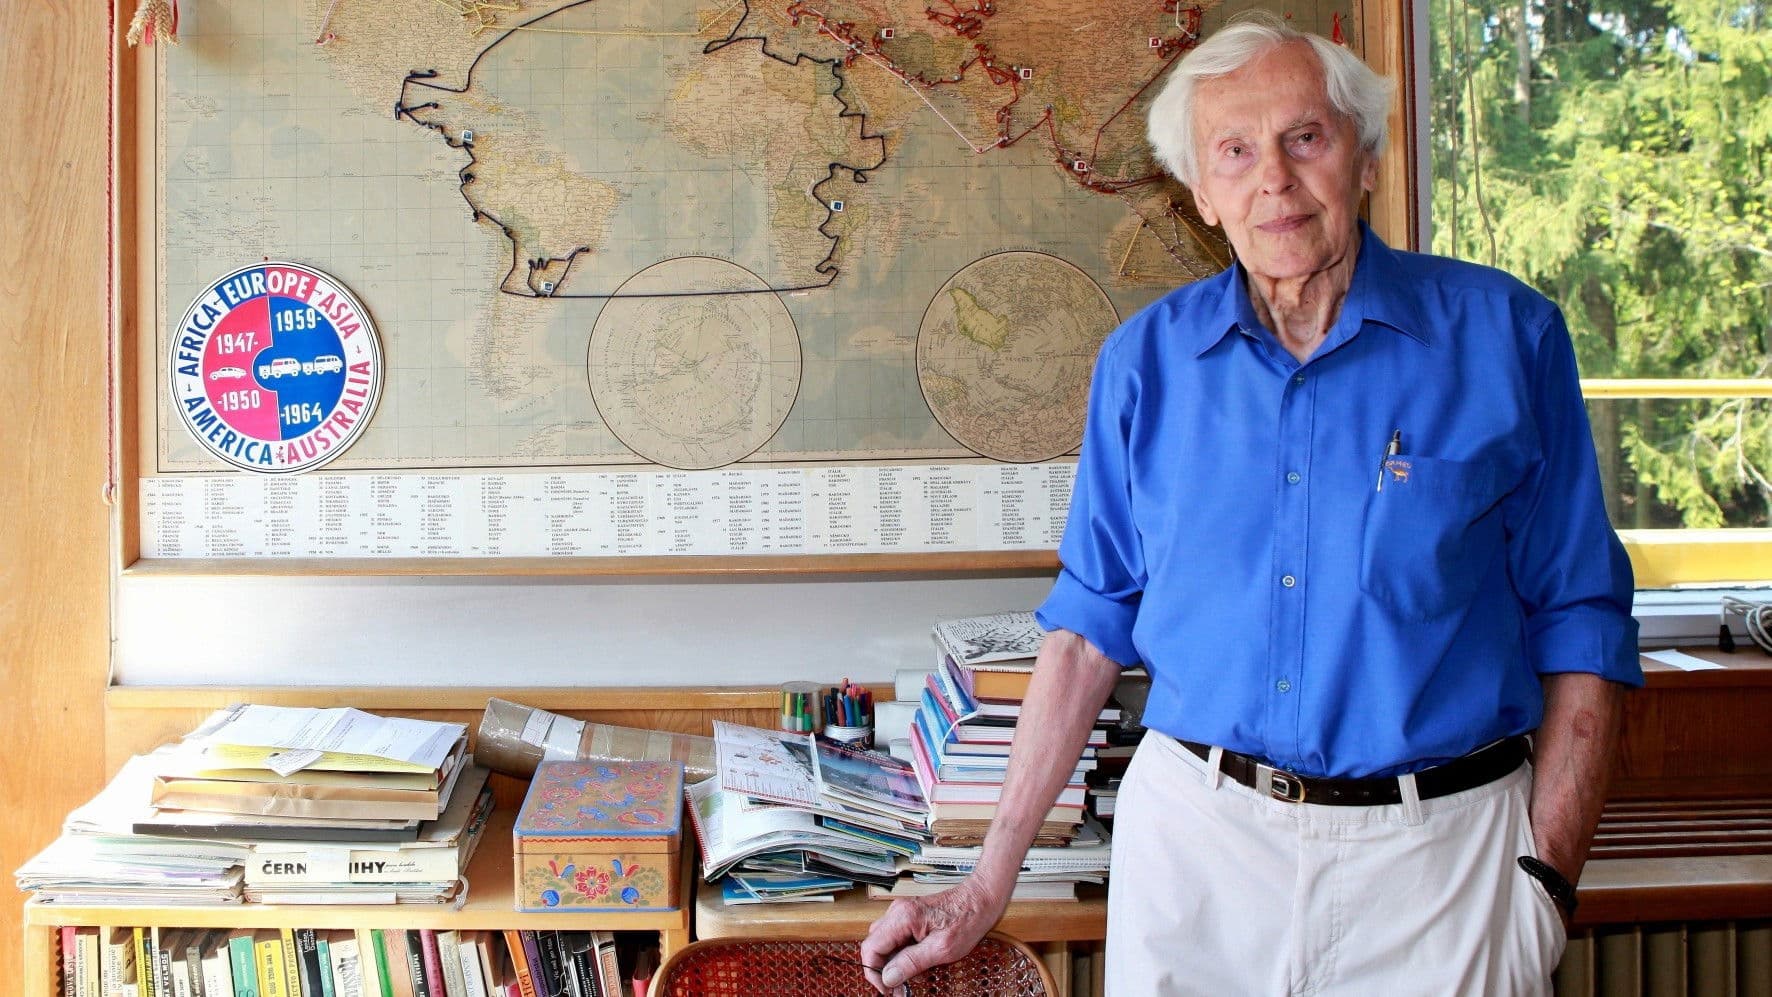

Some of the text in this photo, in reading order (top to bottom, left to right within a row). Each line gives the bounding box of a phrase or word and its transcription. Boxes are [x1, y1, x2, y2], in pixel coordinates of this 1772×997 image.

[222, 269, 311, 303] EUROPE
[178, 303, 222, 377] AFRICA
[318, 292, 361, 340] ASIA
[184, 396, 273, 466] AMERICA
[287, 361, 371, 465] AUSTRALIA
[262, 860, 307, 875] ČERN
[348, 861, 386, 874] IHY
